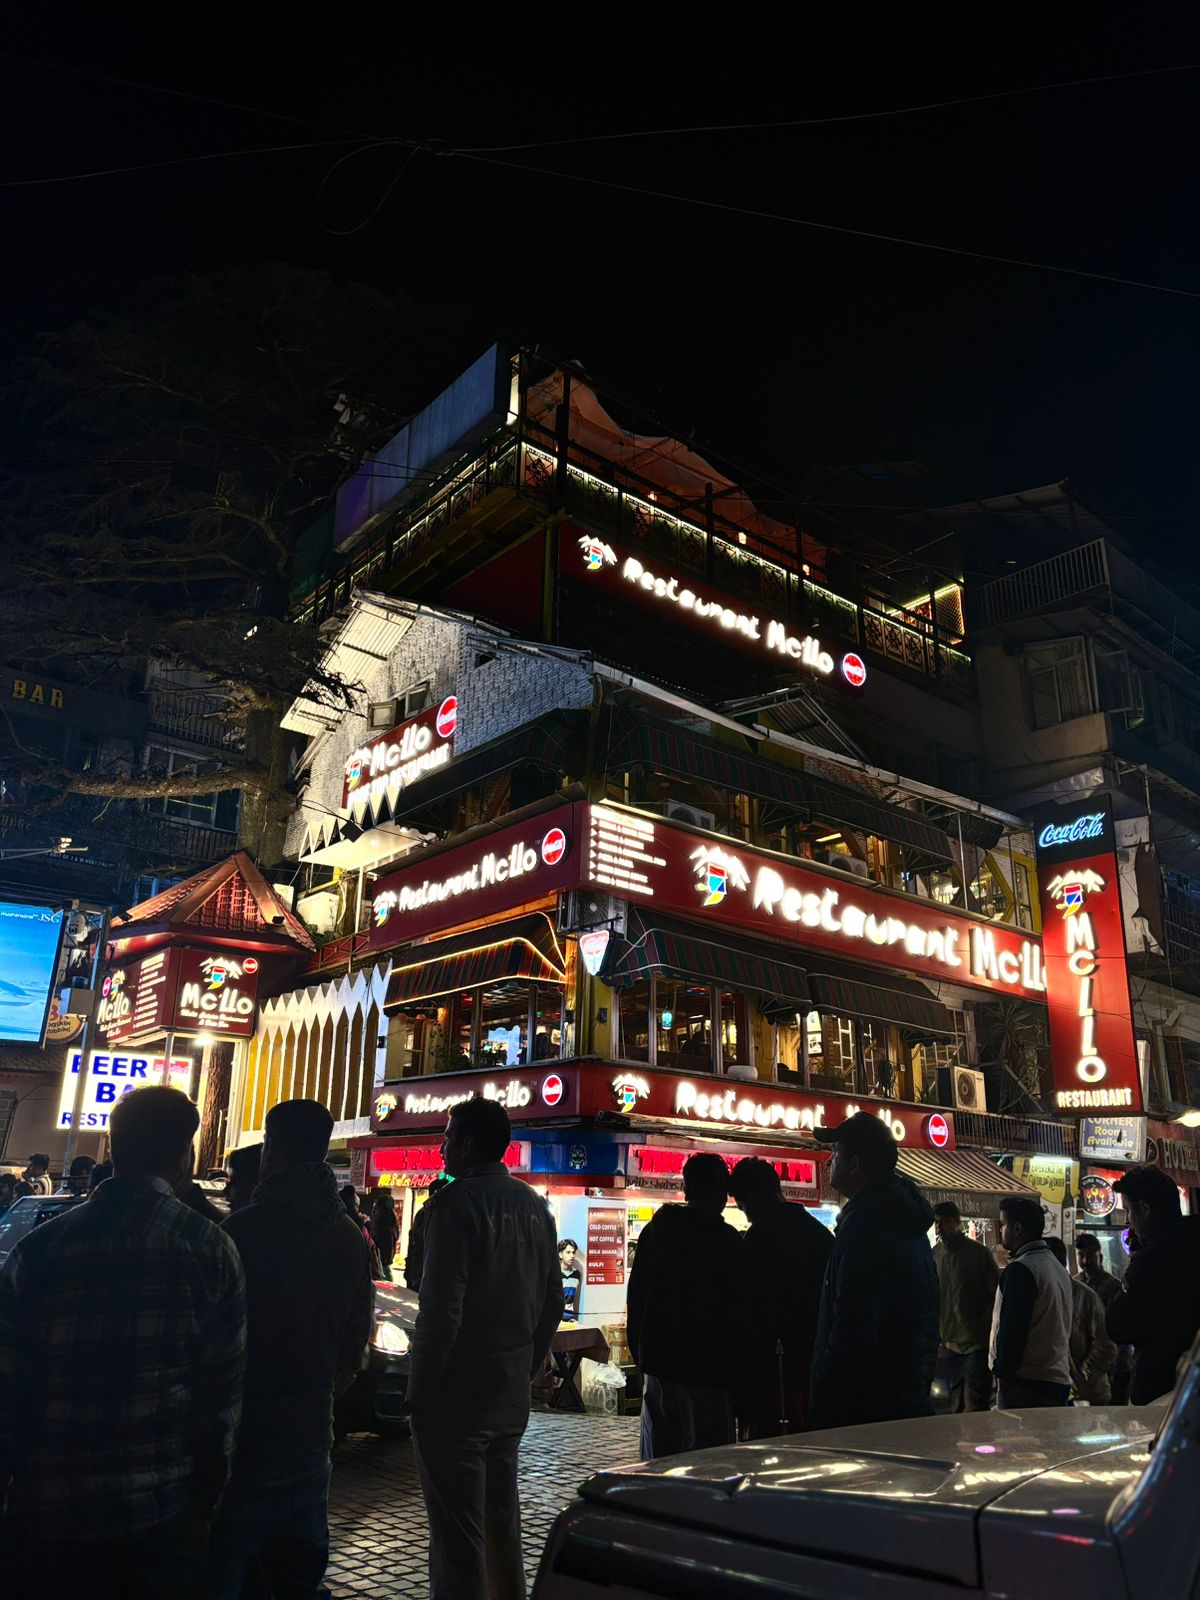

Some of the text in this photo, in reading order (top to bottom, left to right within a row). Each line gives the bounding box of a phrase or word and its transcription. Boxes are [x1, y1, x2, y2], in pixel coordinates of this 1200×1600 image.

[623, 557, 760, 640] Restaurant
[11, 678, 65, 709] BAR
[1038, 812, 1106, 848] Coca-Cola
[398, 863, 479, 912] Restaurant
[753, 866, 961, 967] Restaurant
[673, 1080, 827, 1130] Restaurant
[1057, 1087, 1132, 1108] RESTAURANT
